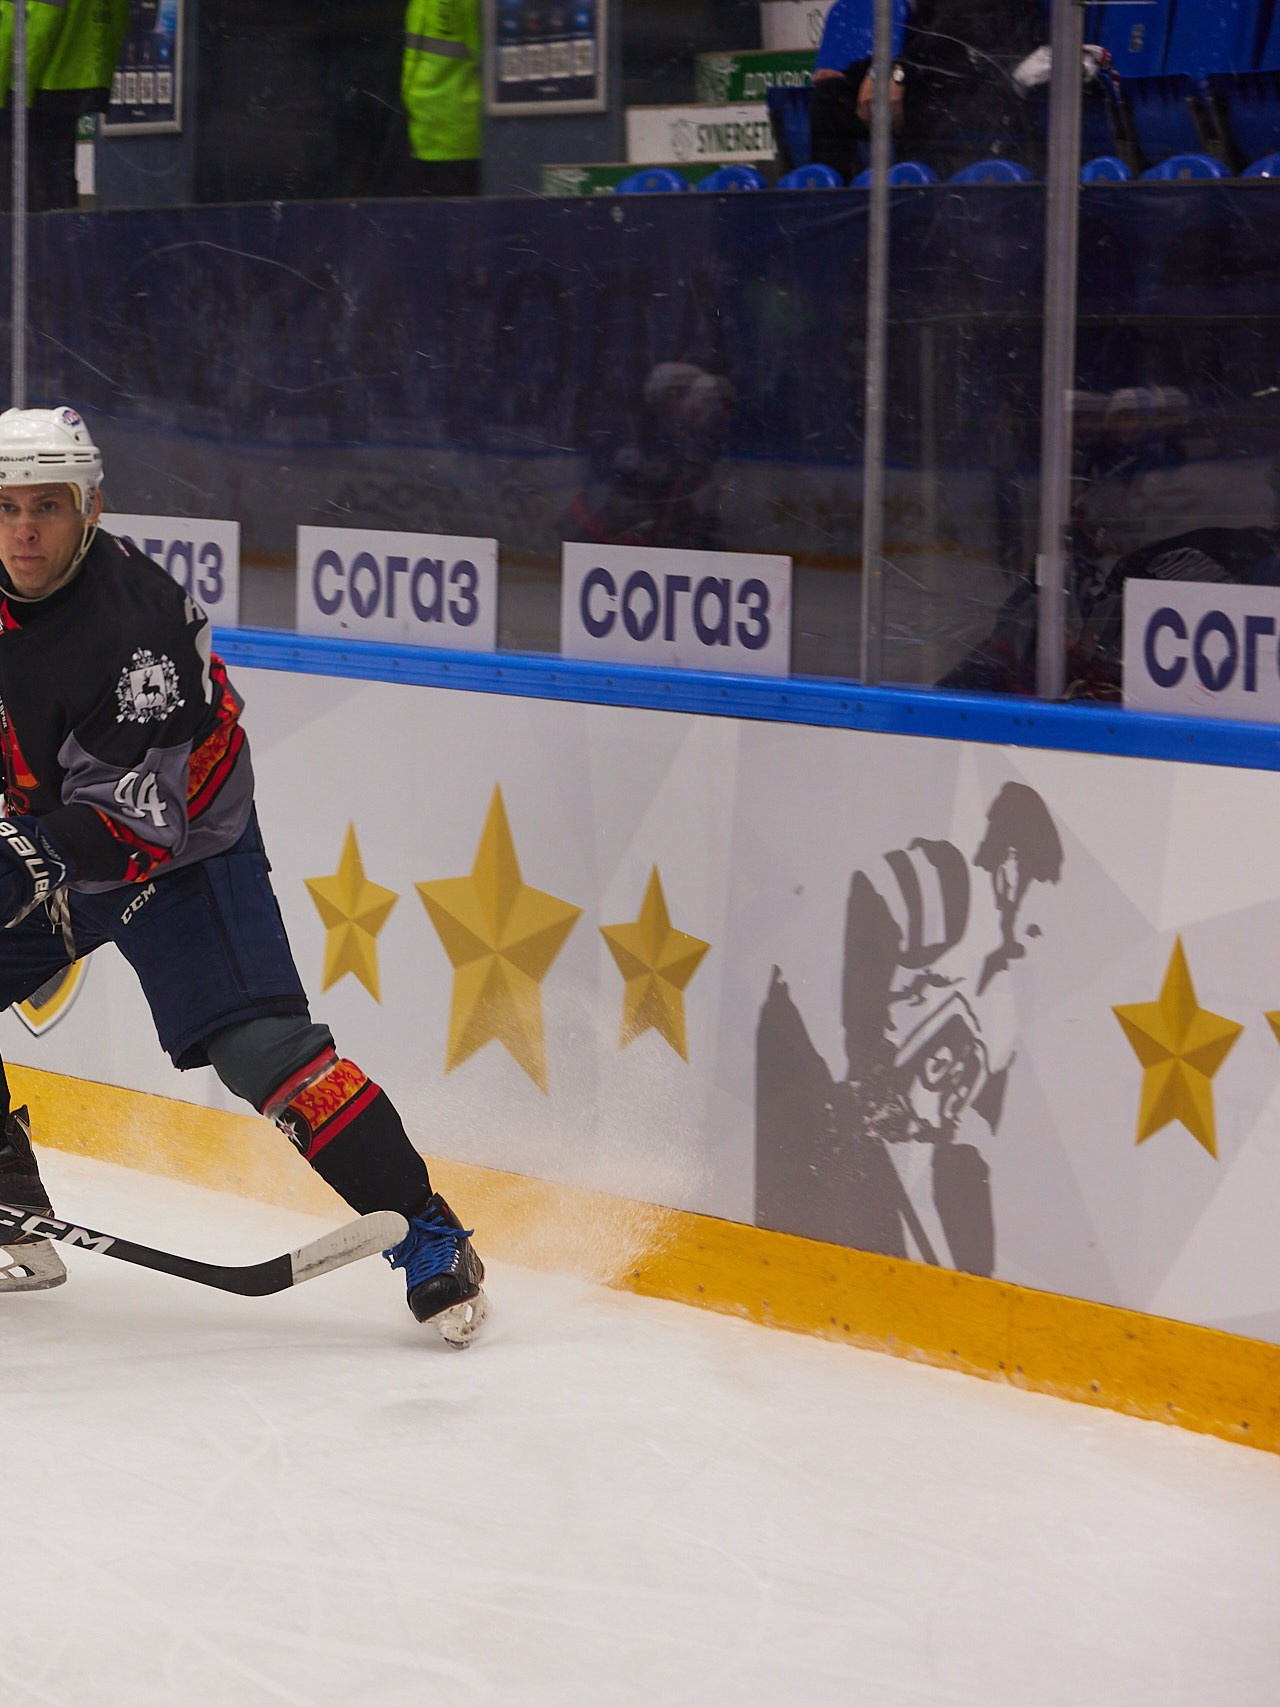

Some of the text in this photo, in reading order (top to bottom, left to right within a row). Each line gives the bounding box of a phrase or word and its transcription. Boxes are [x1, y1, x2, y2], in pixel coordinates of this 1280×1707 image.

[697, 121, 773, 152] SYNERGET
[1144, 606, 1280, 693] сог
[120, 883, 157, 925] CCM
